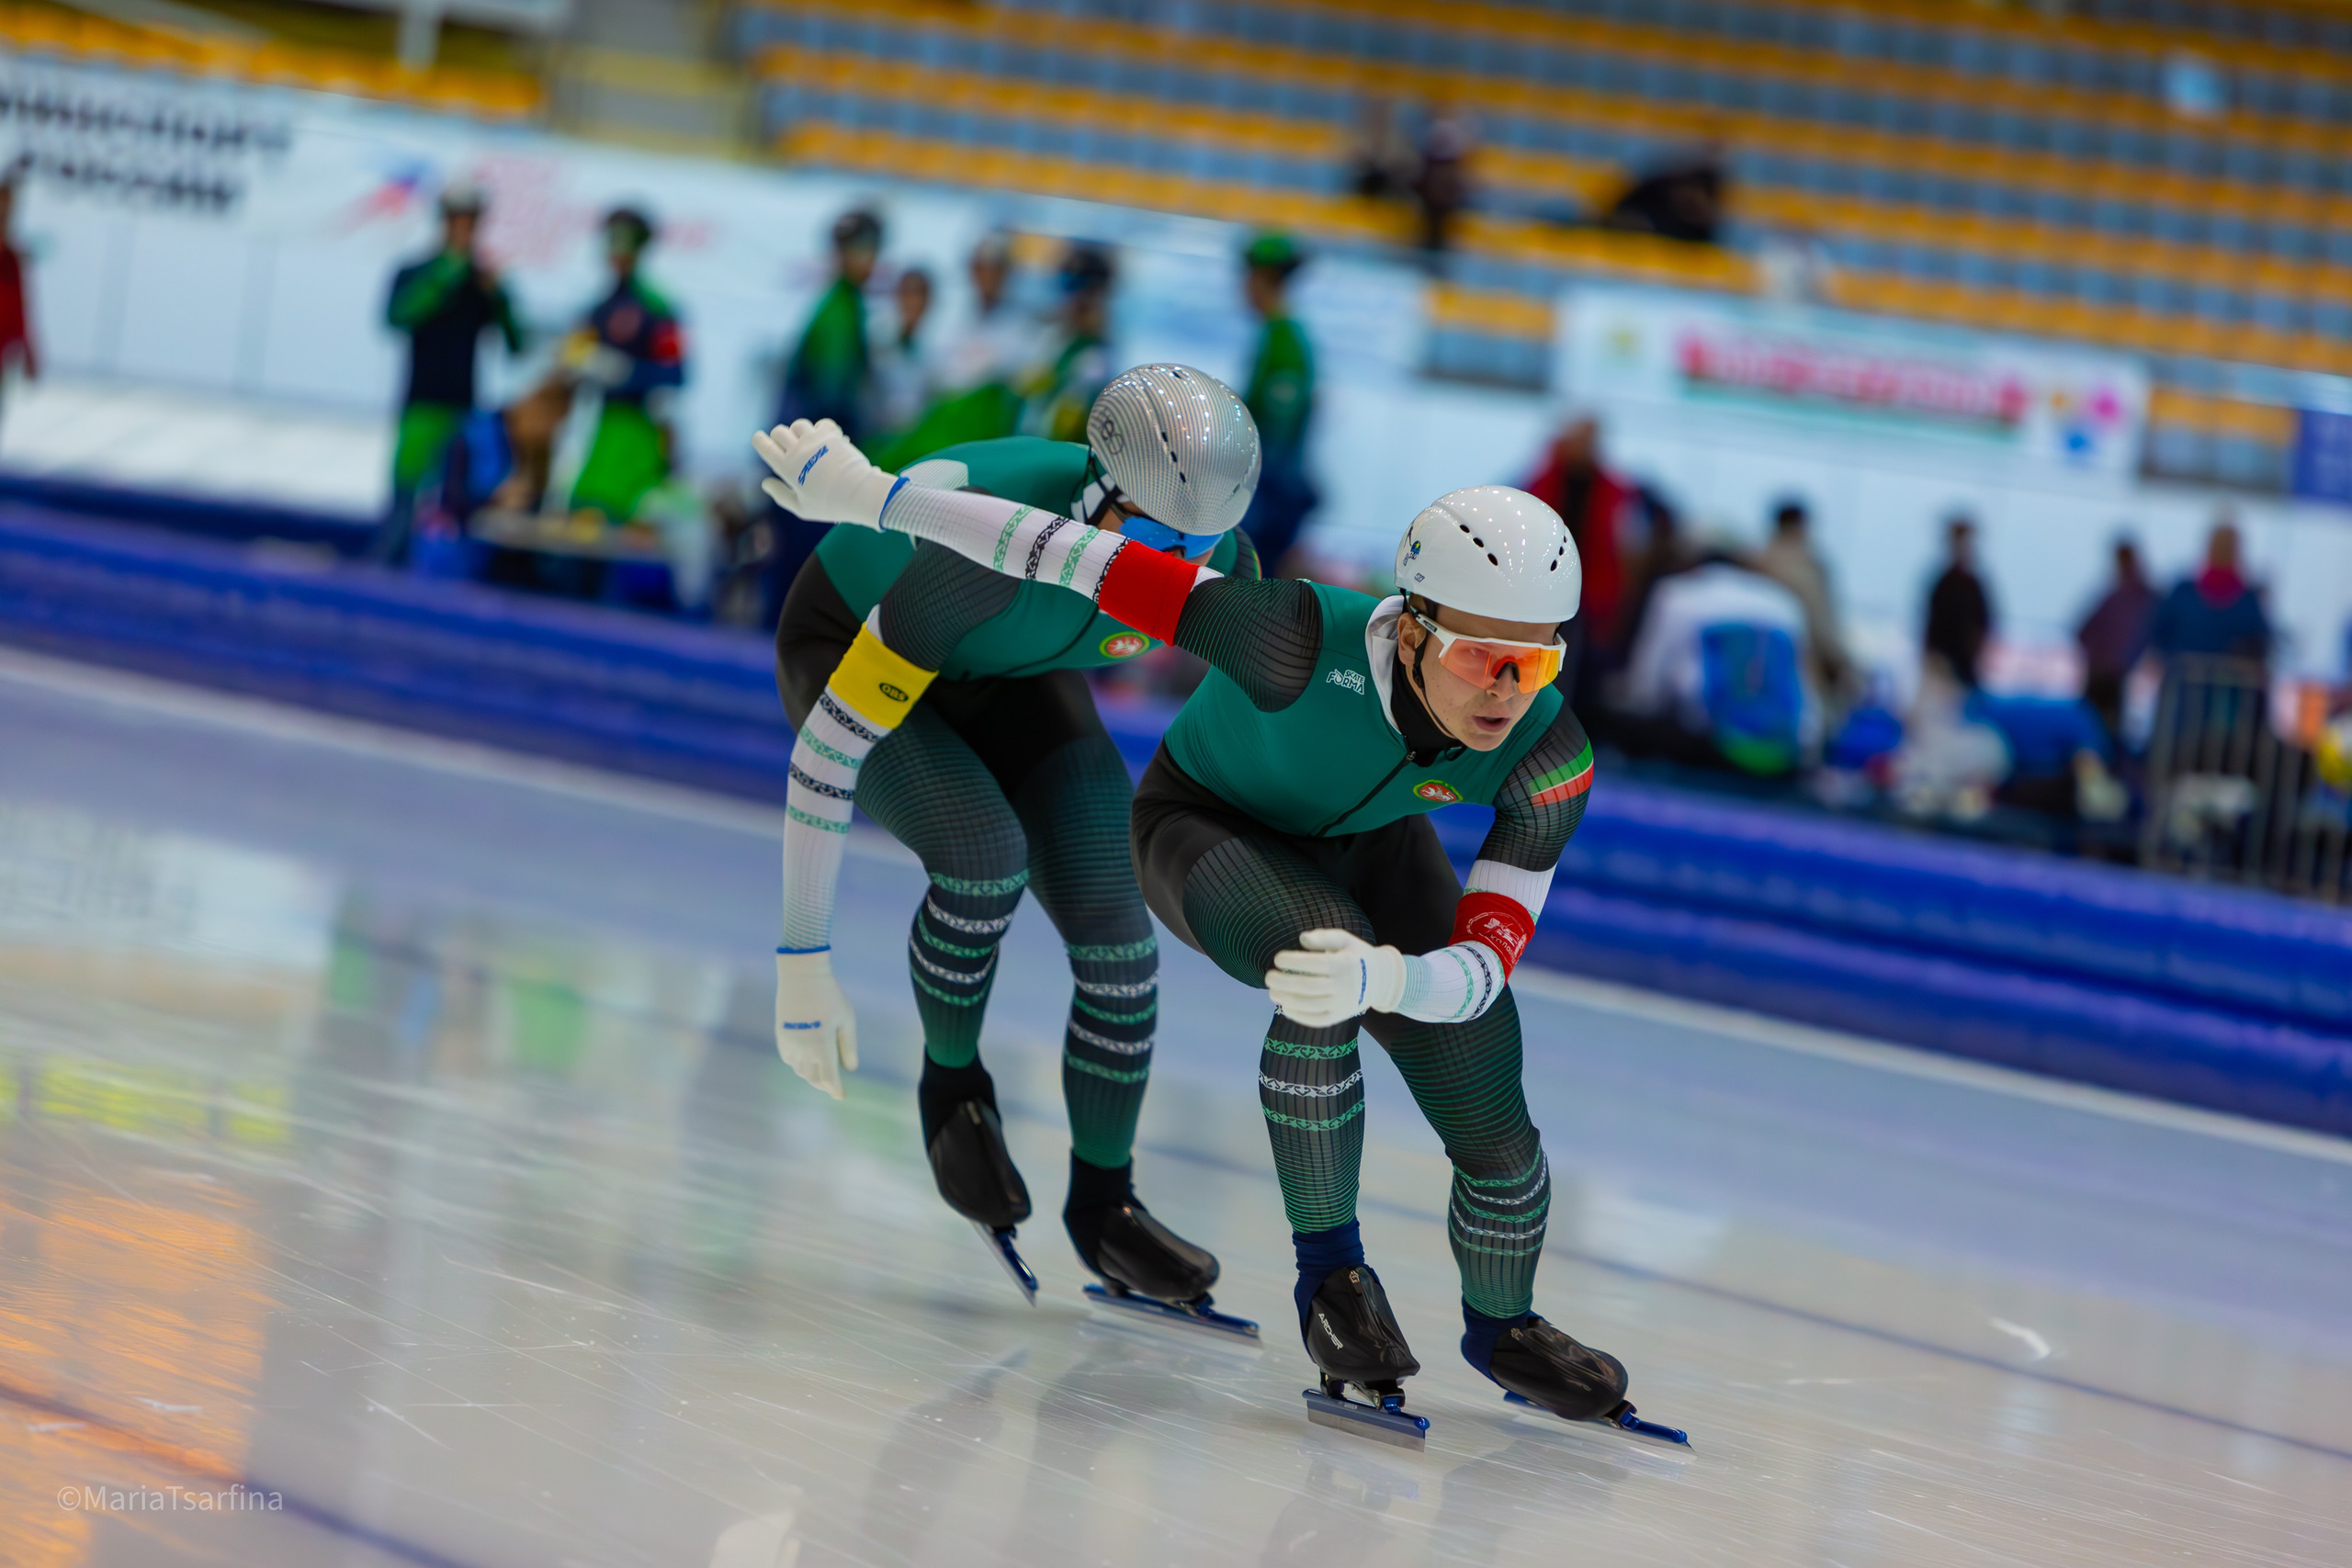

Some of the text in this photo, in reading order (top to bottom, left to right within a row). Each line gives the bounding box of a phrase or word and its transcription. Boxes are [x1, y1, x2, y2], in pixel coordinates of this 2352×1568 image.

[1326, 669, 1364, 694] FORMA
[1344, 670, 1364, 684] SKATE
[1318, 1314, 1343, 1349] ARCHER
